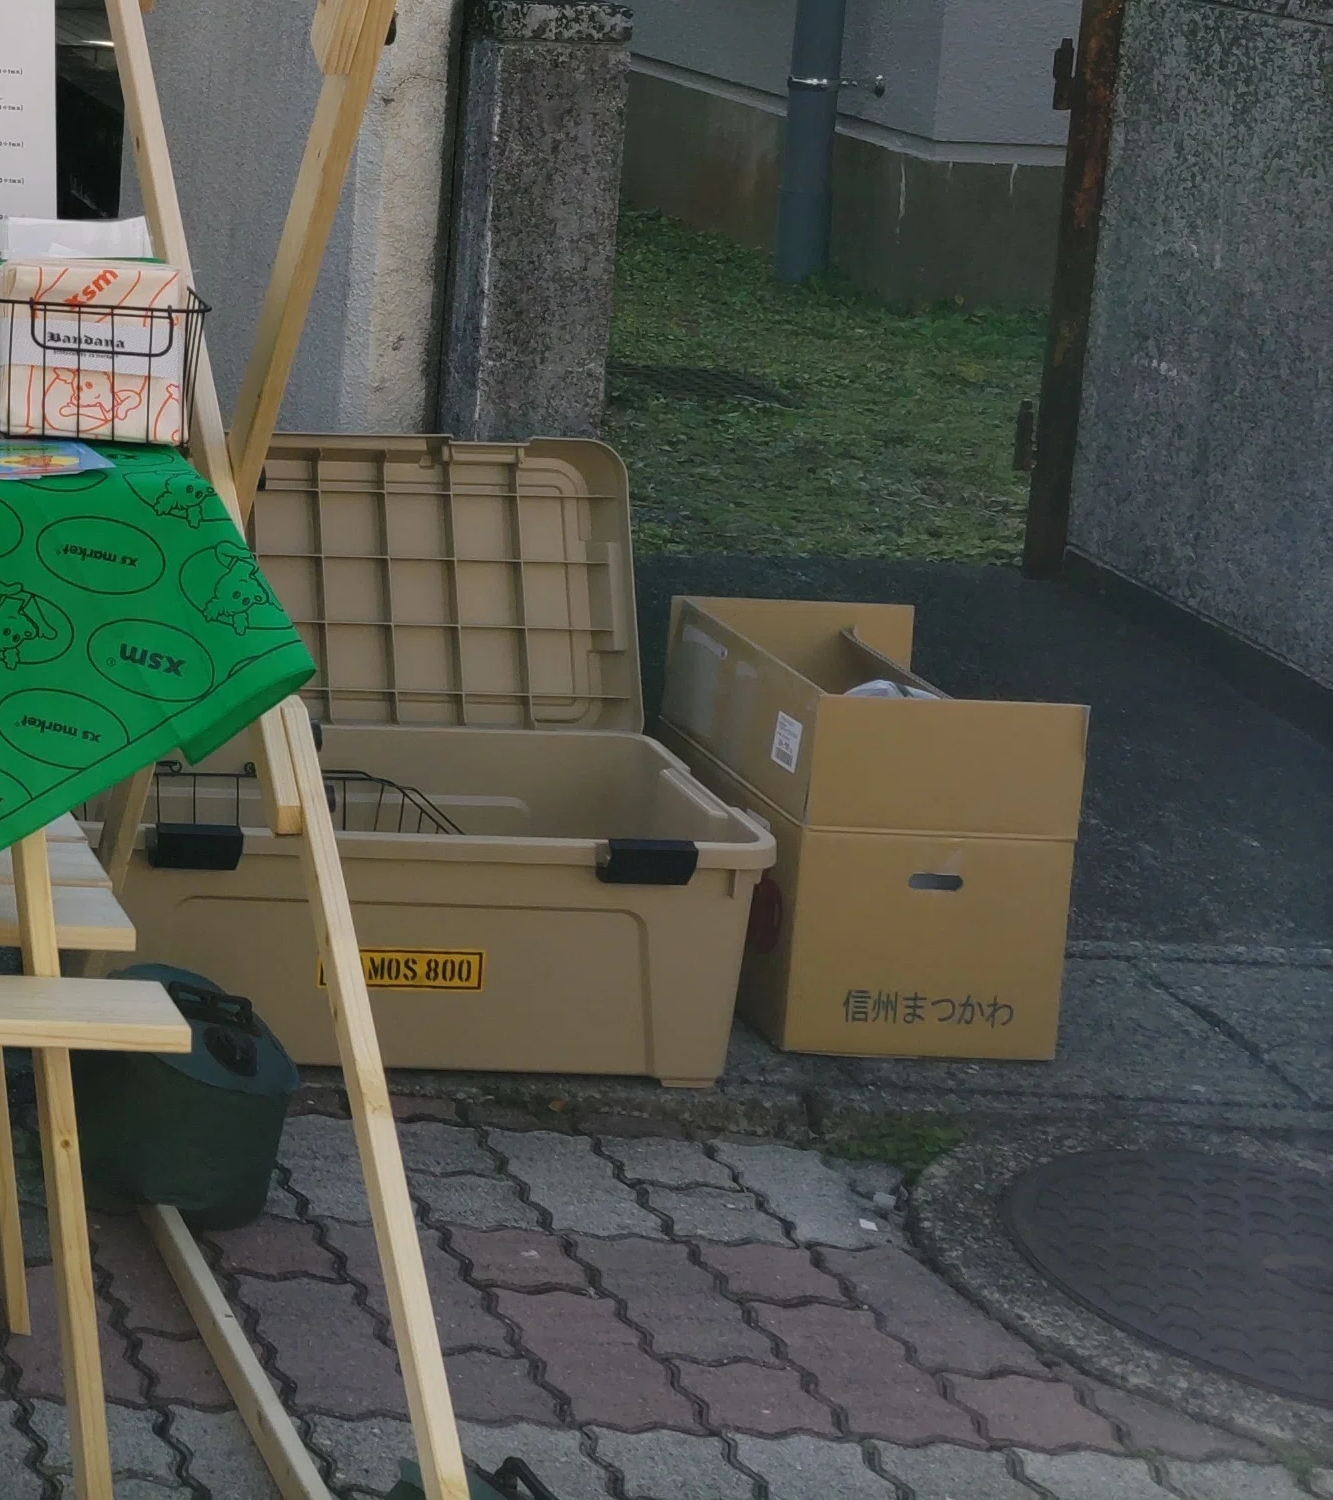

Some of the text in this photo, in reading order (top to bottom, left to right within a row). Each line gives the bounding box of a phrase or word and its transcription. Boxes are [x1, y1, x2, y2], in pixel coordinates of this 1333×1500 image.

[64, 269, 119, 310] xsm
[47, 331, 125, 349] Bandana
[63, 543, 139, 568] xs market
[119, 643, 187, 677] xsm
[21, 714, 102, 743] xs market
[361, 956, 472, 983] MOS 800
[842, 988, 1015, 1029] 信州まつかわ
